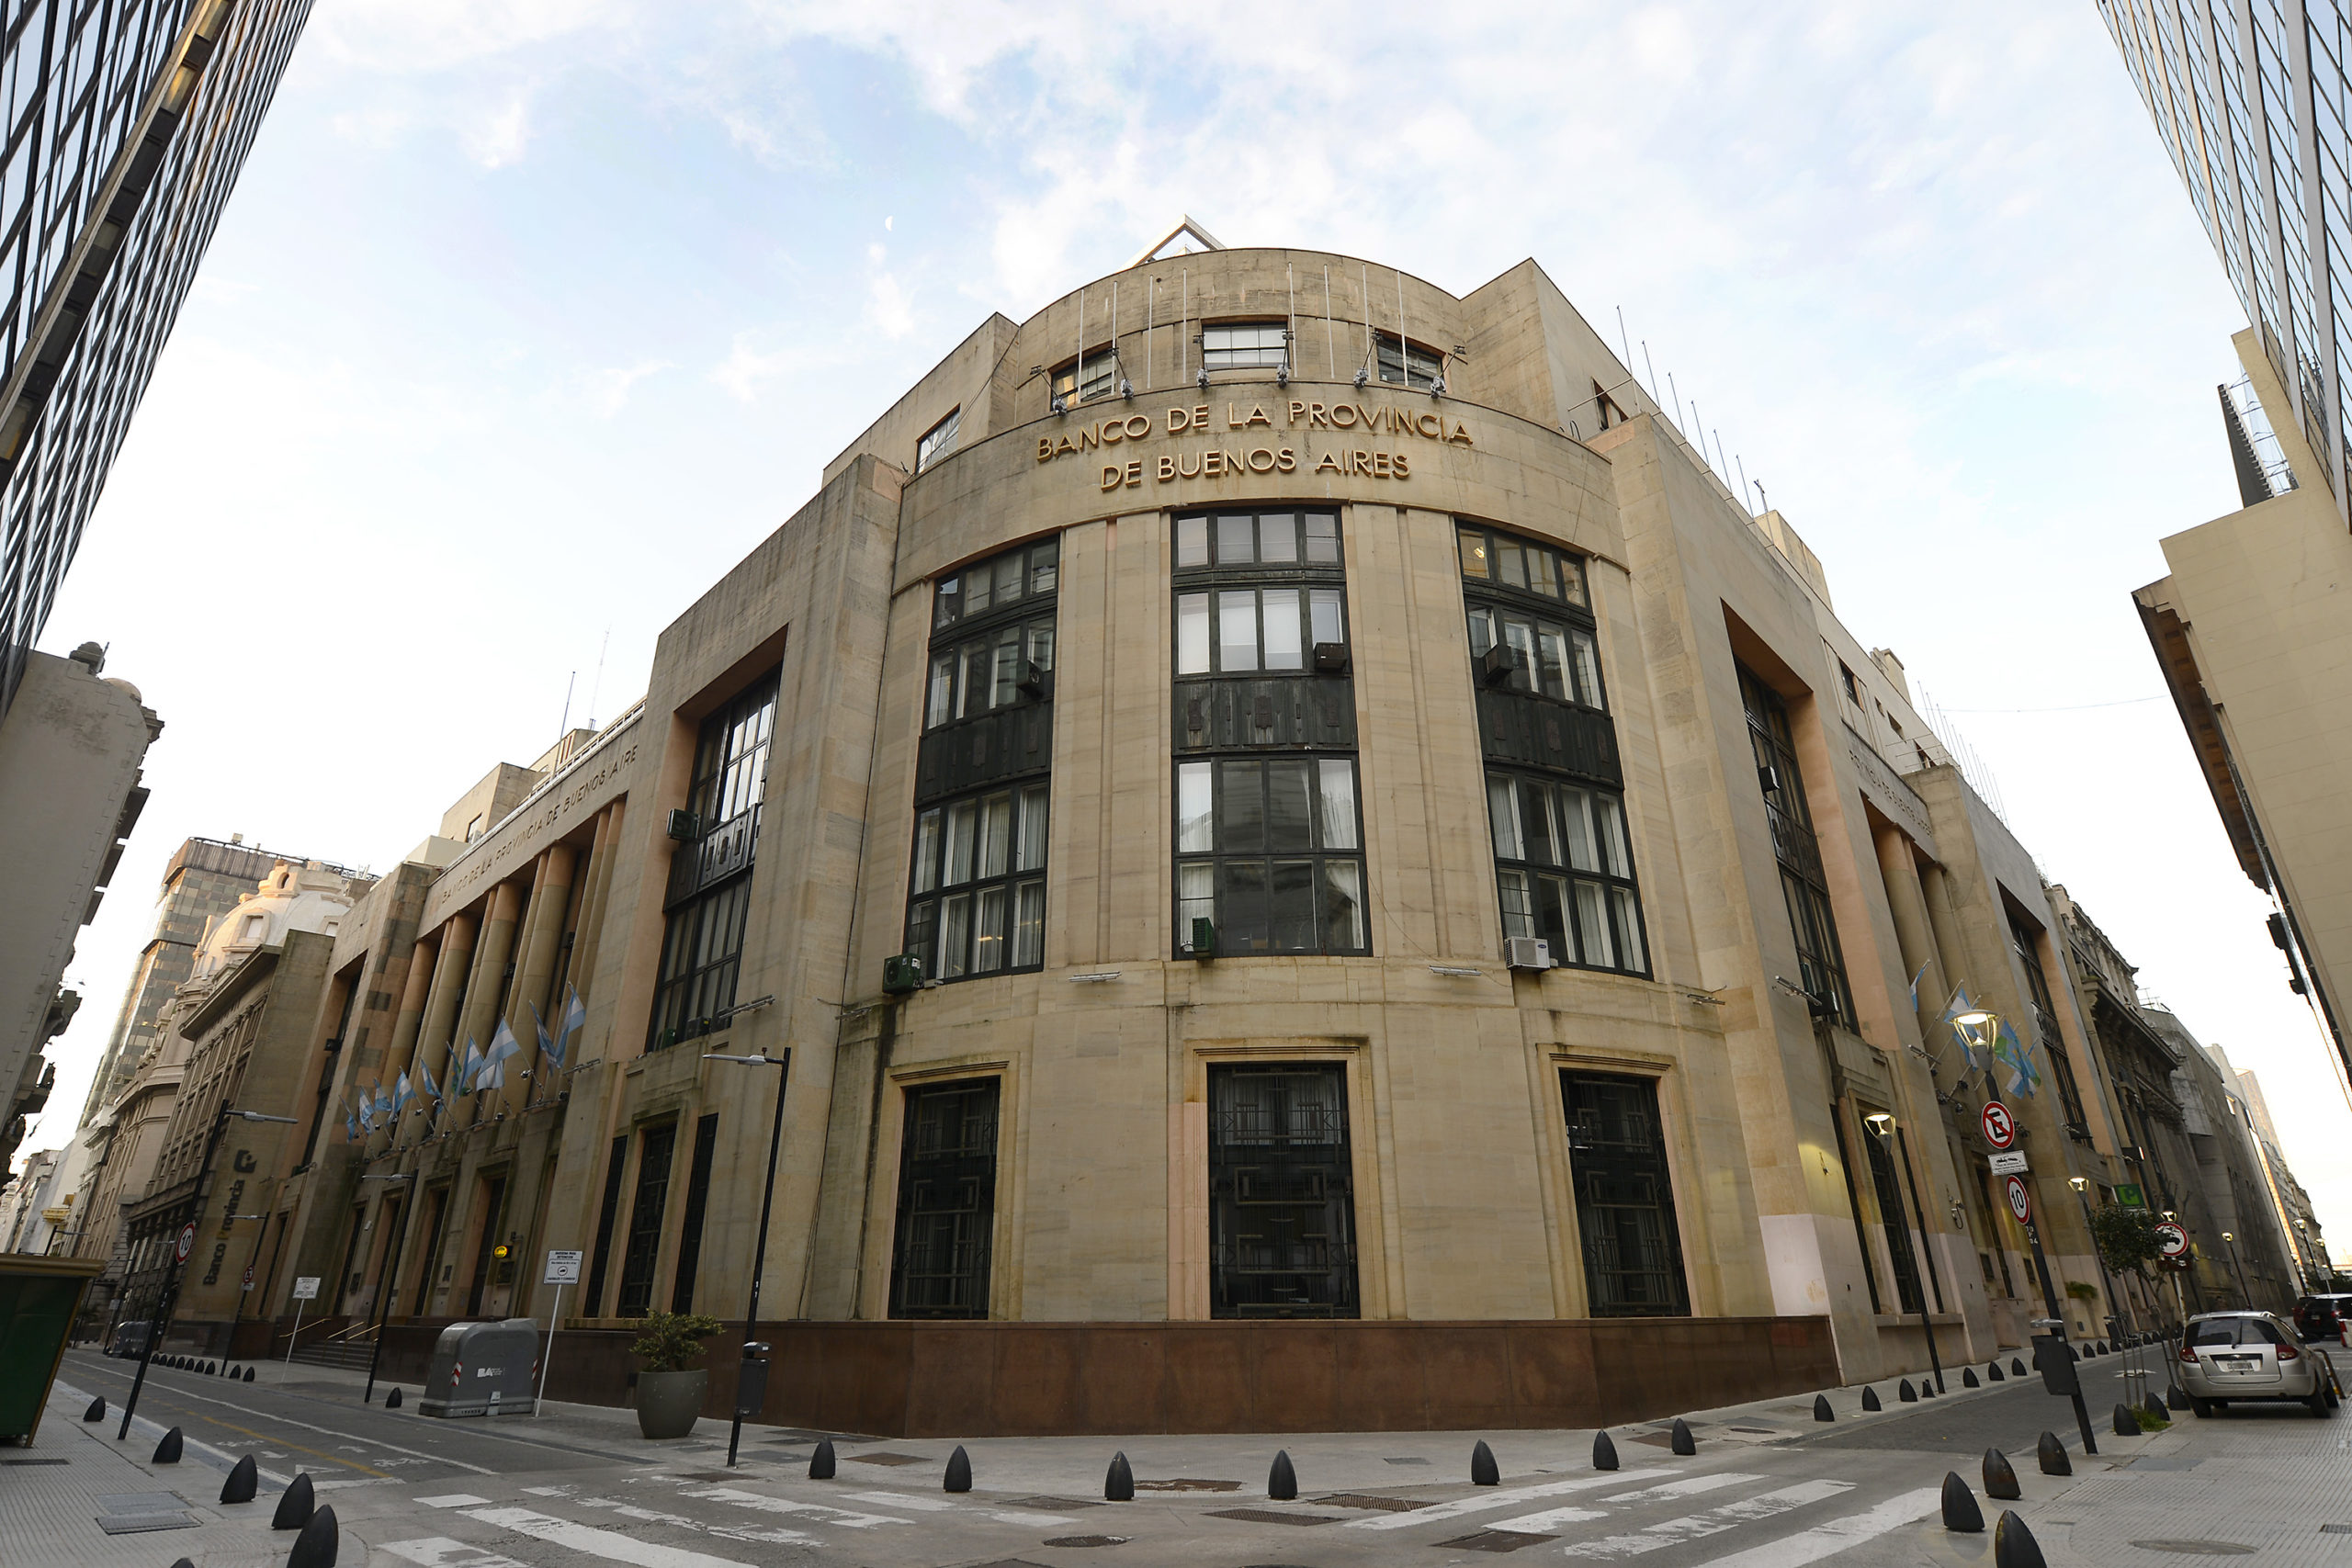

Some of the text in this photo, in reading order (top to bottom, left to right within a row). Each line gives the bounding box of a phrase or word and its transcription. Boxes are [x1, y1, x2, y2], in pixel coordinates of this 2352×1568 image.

[1036, 400, 1474, 462] BANCO DE LA PROVINCIA
[1101, 447, 1410, 491] DE BUENOS AIRES
[546, 804, 560, 827] DE
[562, 769, 606, 814] BUENOS
[609, 744, 639, 779] AIRE
[2011, 1189, 2025, 1211] 10
[181, 1234, 192, 1251] 10
[203, 1179, 245, 1285] Banco Provincia
[477, 1367, 493, 1378] BA
